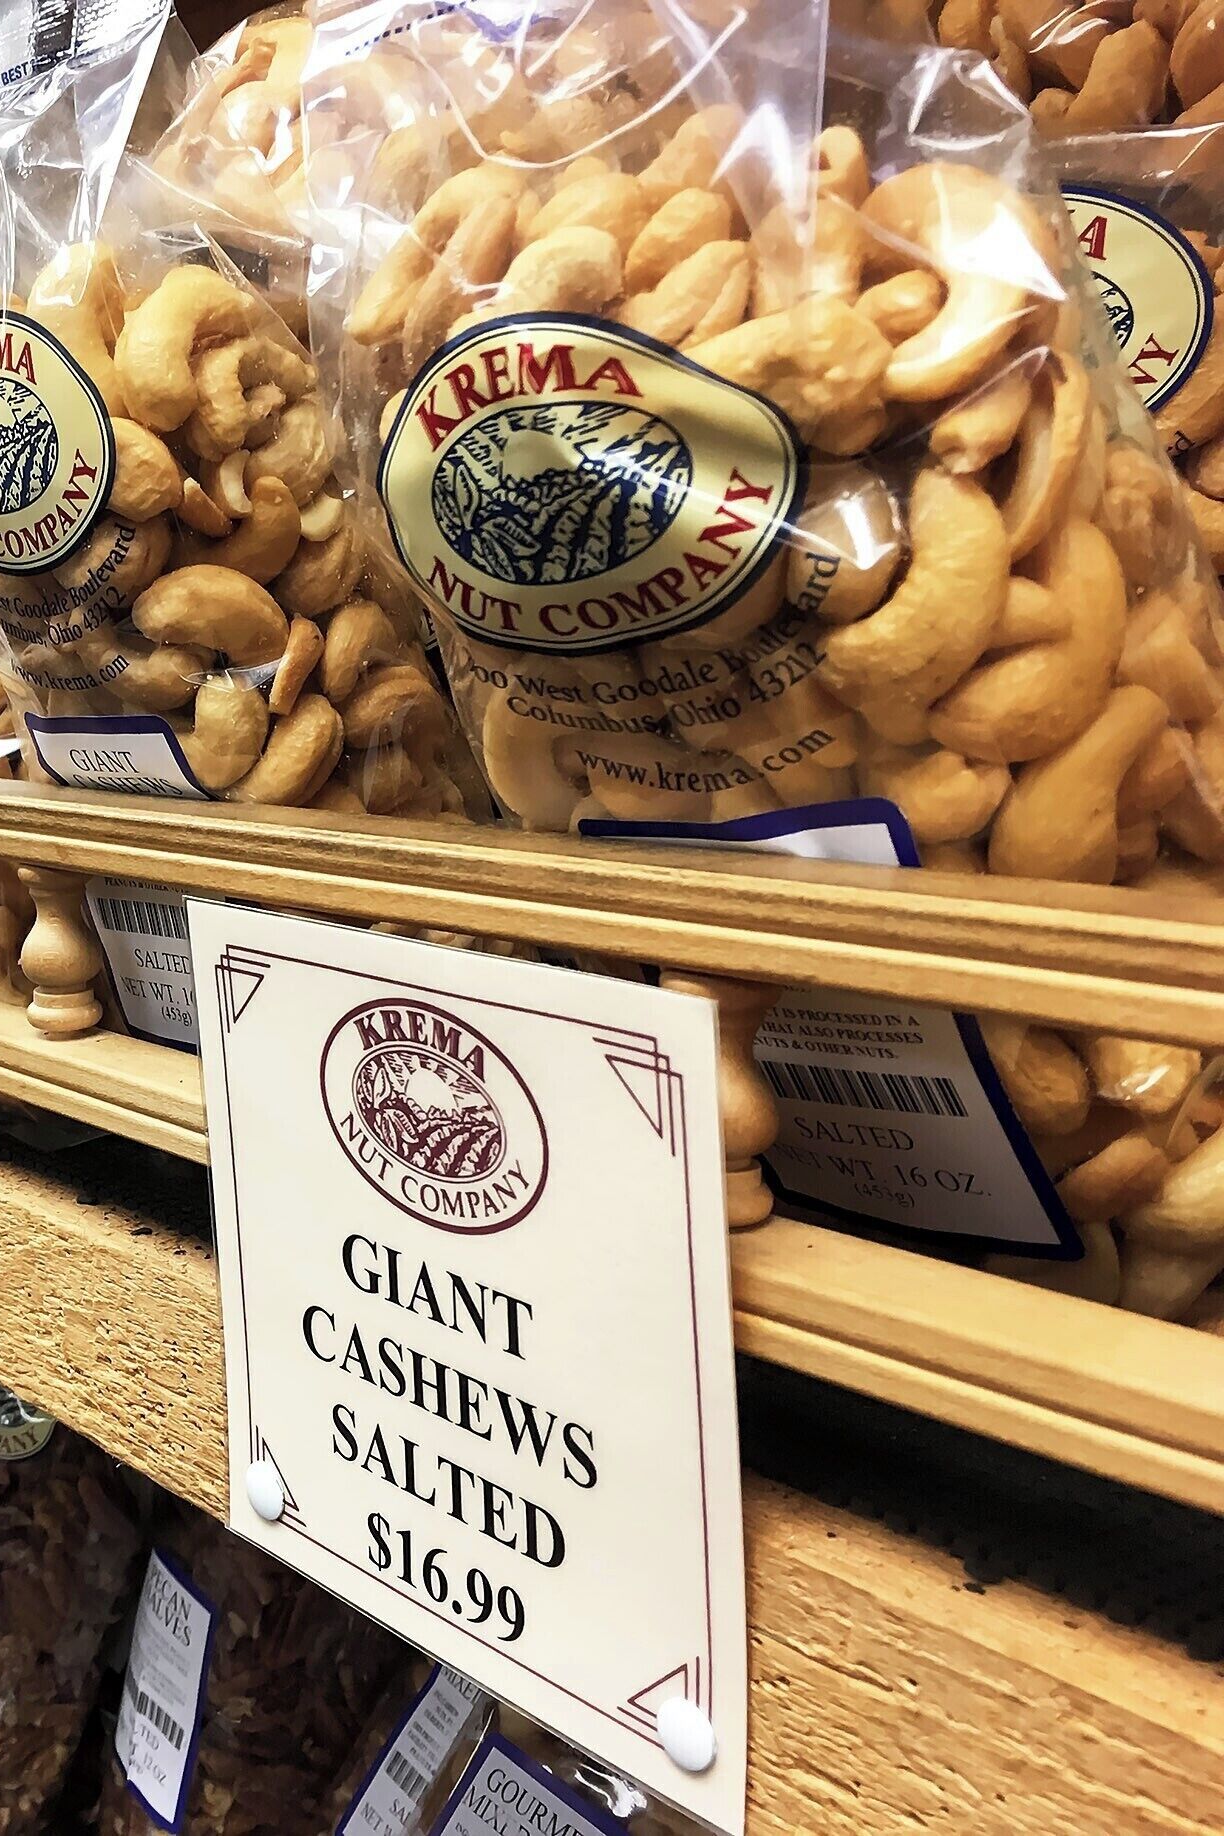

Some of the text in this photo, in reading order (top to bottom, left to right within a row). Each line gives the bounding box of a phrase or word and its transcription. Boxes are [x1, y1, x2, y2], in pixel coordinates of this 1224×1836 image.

[1, 61, 29, 86] BEST
[415, 343, 645, 452] KREMA
[14, 588, 70, 619] Goodale
[69, 522, 136, 608] Boulevard
[427, 467, 775, 638] NUT COMPANY
[0, 586, 126, 648] umbus, Ohio 43212
[514, 673, 585, 704] West
[592, 660, 717, 706] Goodale
[715, 552, 842, 675] Boulevard
[670, 694, 742, 729] Ohio
[747, 642, 828, 704] 43212
[69, 749, 140, 774] GIANT
[576, 727, 837, 794] www.krema.com
[120, 976, 194, 1007] NET WT. 1
[161, 1005, 193, 1027] (453g)
[797, 1009, 883, 1027] PROCESSED
[885, 1013, 902, 1027] IN
[907, 1014, 921, 1027] A
[353, 1010, 486, 1083] KREMA
[798, 1025, 835, 1040] ALSO
[836, 1028, 925, 1045] PROCESSES
[804, 1041, 854, 1056] OTHER
[340, 1111, 530, 1219] NUT COMPANY
[793, 1116, 915, 1151] SALTED
[893, 1164, 928, 1188] 16
[934, 1169, 992, 1197] OZ.
[341, 1233, 533, 1361] GIANT
[301, 1305, 598, 1490] CASHEWS
[332, 1403, 567, 1569] SALTED
[367, 1511, 526, 1643] $16.99
[149, 1591, 192, 1648] ALVES
